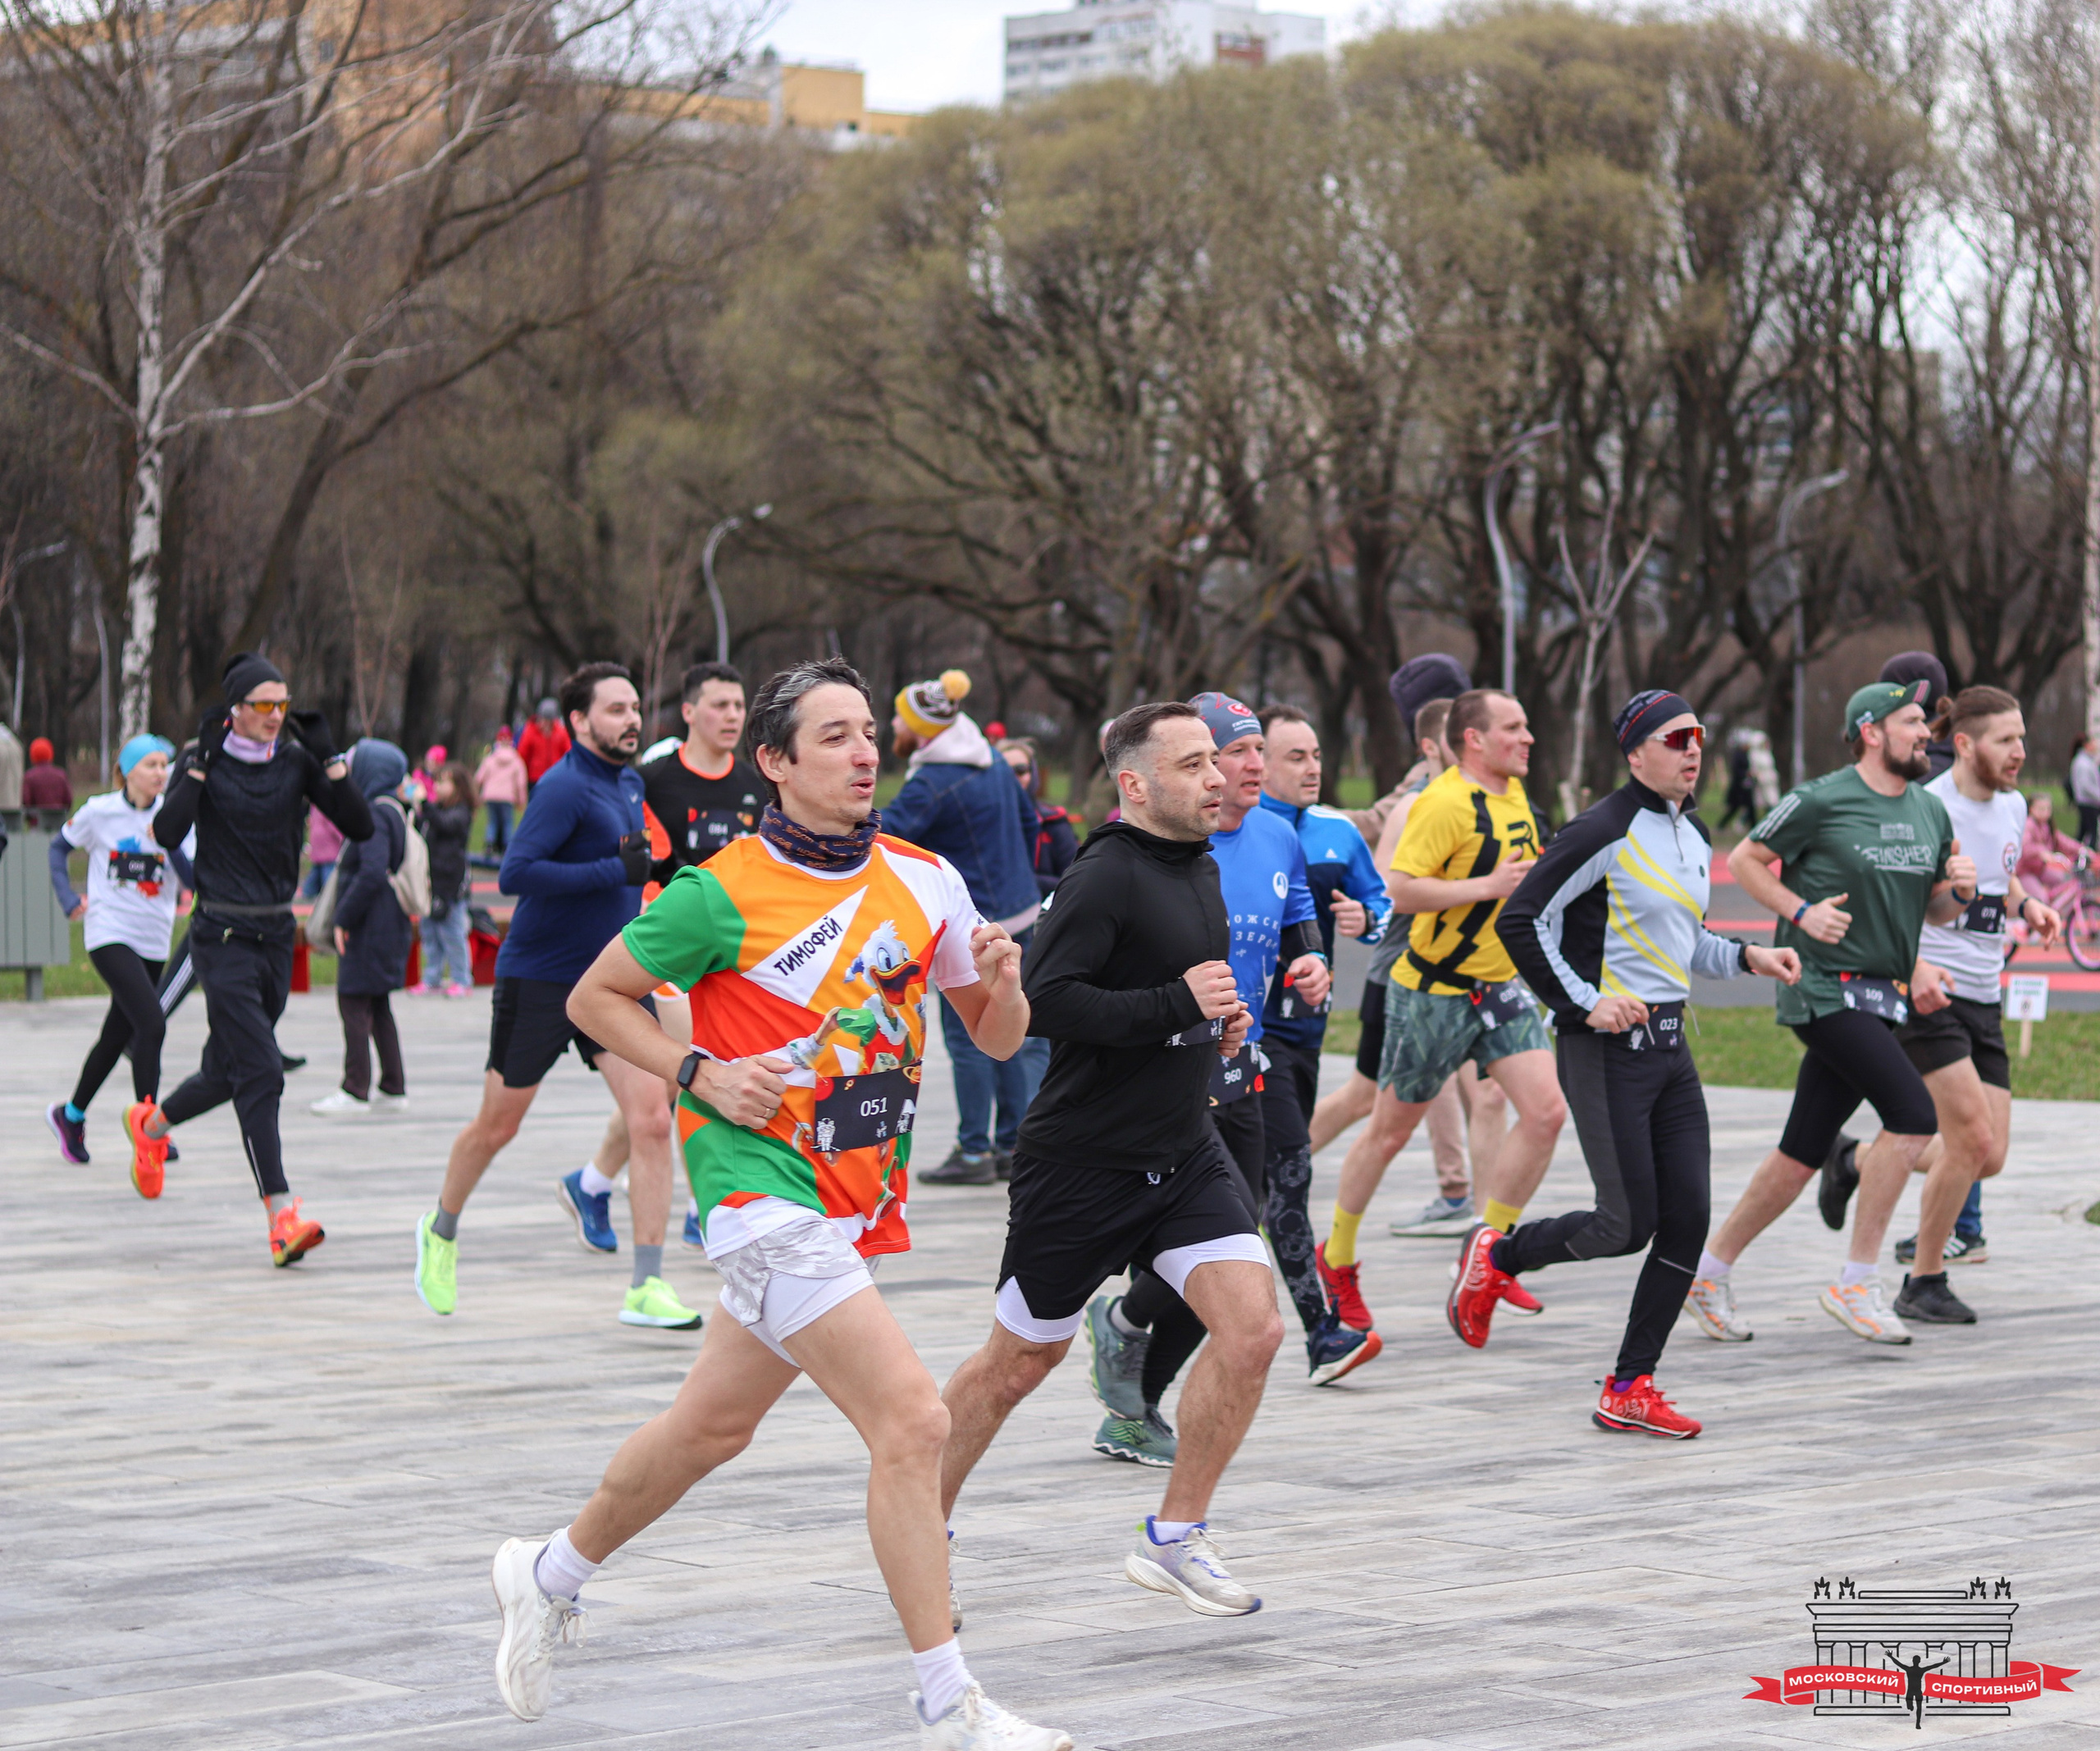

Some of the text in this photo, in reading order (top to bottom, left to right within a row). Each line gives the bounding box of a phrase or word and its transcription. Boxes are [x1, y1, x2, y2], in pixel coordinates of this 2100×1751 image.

[774, 915, 842, 976] ТИМОФЕЙ
[1865, 987, 1883, 1002] 109
[1659, 1018, 1678, 1031] 023
[1224, 1068, 1243, 1084] 960
[860, 1097, 888, 1116] 051
